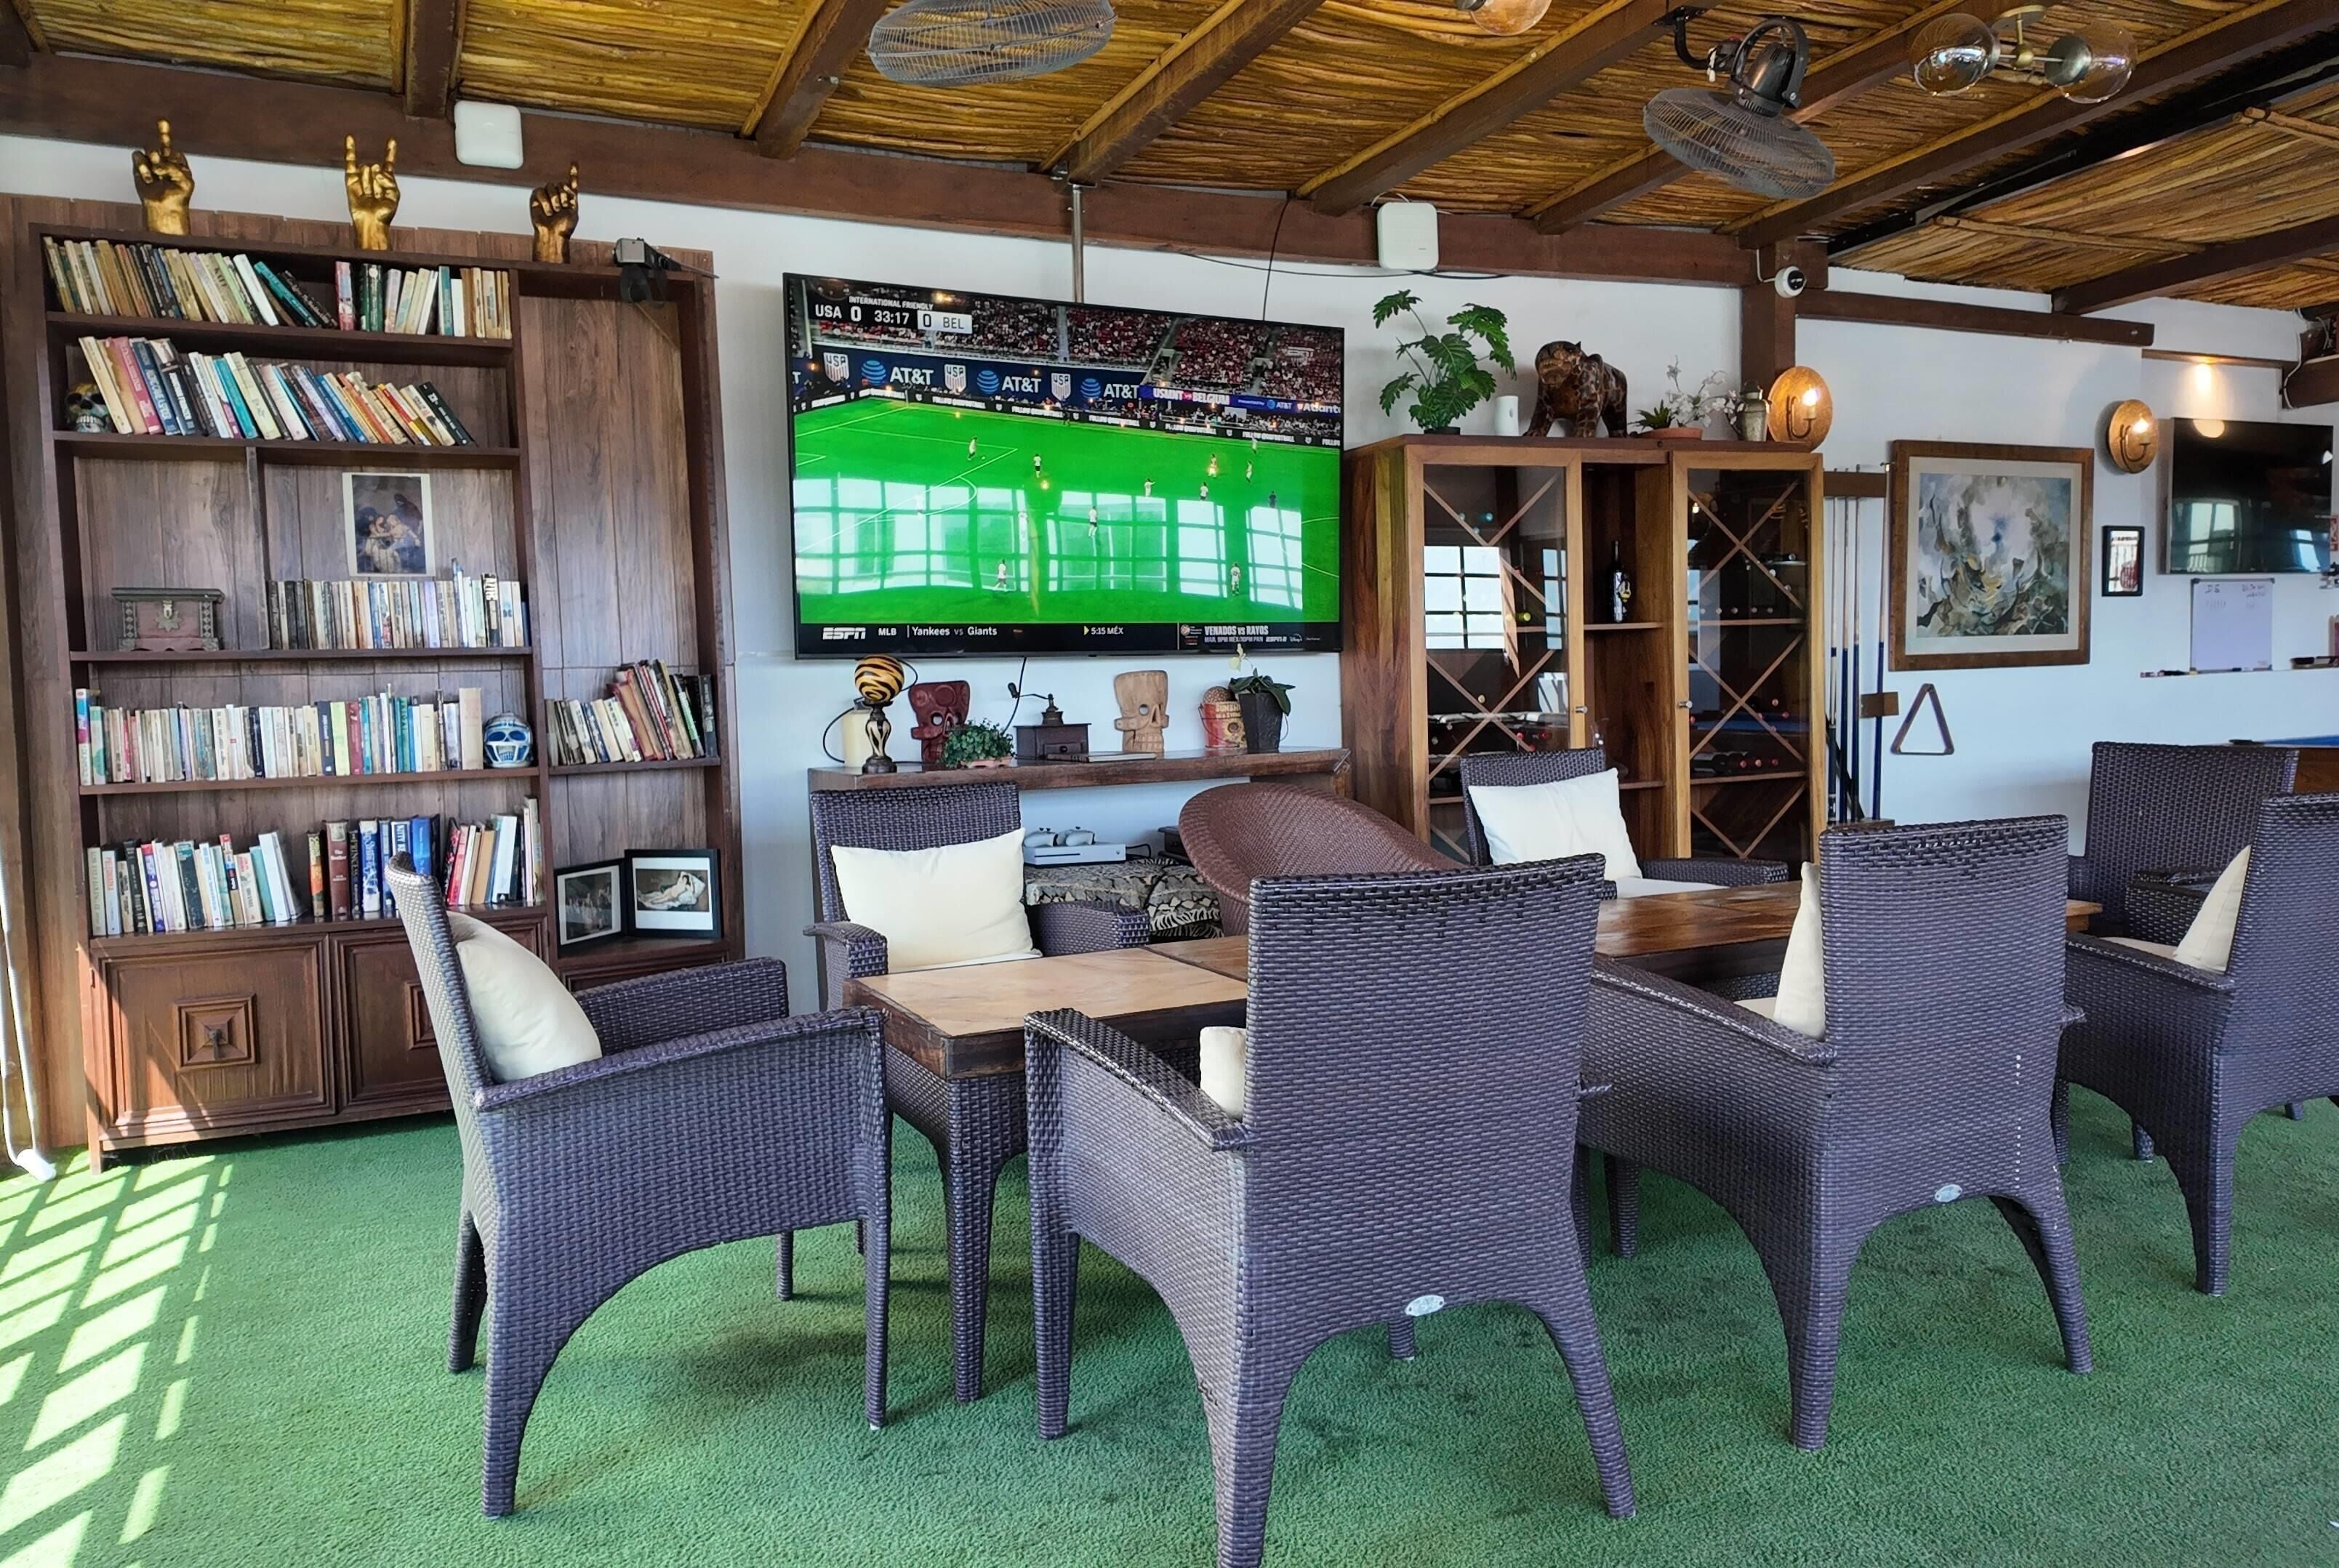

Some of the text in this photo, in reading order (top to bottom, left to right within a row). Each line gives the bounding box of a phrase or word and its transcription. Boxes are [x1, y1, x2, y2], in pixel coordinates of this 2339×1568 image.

[848, 295, 934, 311] INTERNATIONAL FRIENDLY
[815, 304, 966, 330] USA 0 33:17 0 BEL
[826, 354, 847, 367] USA
[890, 366, 935, 386] AT&T
[945, 366, 965, 377] USA
[1001, 376, 1042, 393] AT&T
[1053, 374, 1070, 385] USA
[1103, 383, 1139, 399] AT&T
[1192, 391, 1230, 405] BELGIUM
[1275, 399, 1293, 409] AT&T
[1304, 402, 1341, 414] Atlant
[822, 627, 866, 640] ESPN
[878, 627, 896, 637] MLB
[912, 626, 950, 637] Yankees
[967, 626, 998, 637] Giants
[1091, 627, 1106, 635] 5:15
[1204, 625, 1237, 636] VENADOS
[1245, 625, 1269, 636] RAYOS
